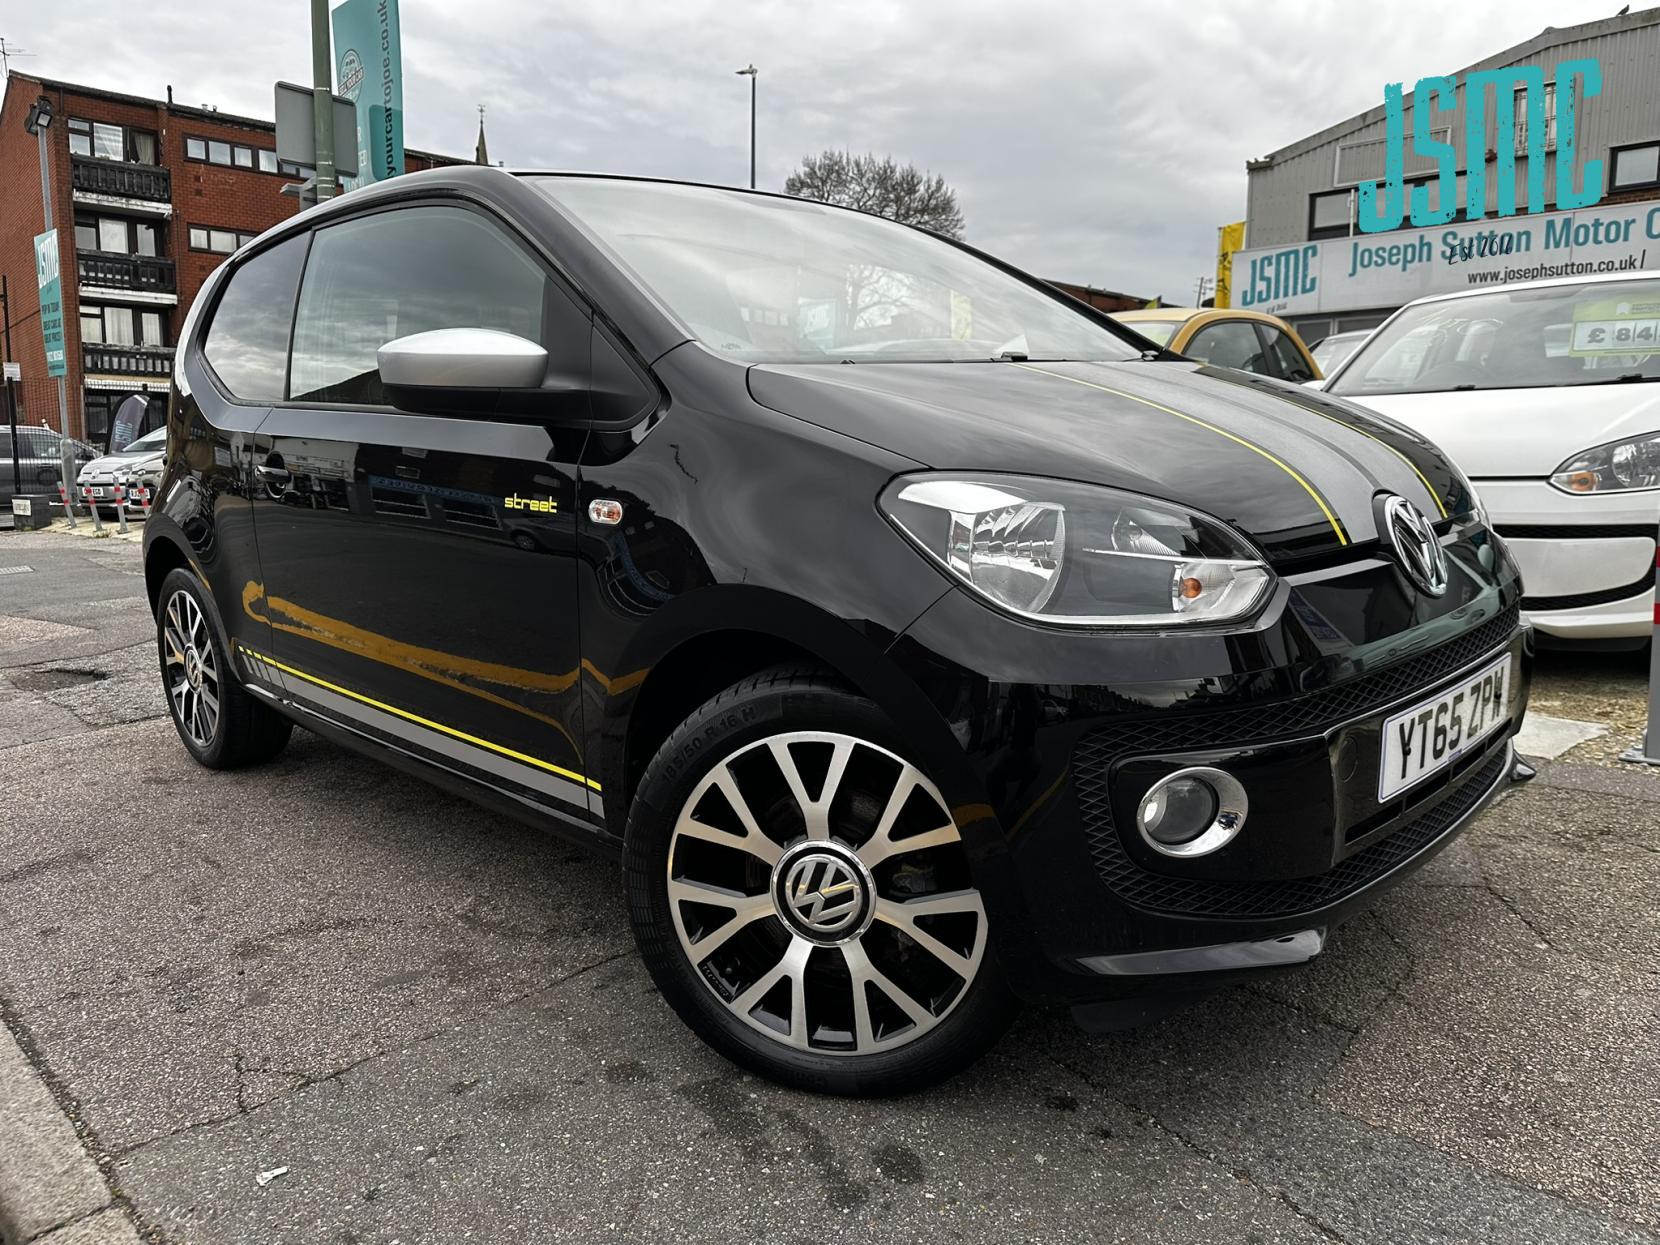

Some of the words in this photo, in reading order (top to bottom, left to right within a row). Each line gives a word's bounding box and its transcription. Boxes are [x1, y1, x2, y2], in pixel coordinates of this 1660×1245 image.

[377, 0, 397, 179] yourcartojoe.co.uk
[1241, 244, 1318, 307] JSMC
[1348, 234, 1433, 277] Joseph
[1441, 230, 1532, 260] Sutton
[1544, 217, 1636, 250] Motor
[504, 492, 558, 514] street
[1399, 692, 1464, 780] YT65
